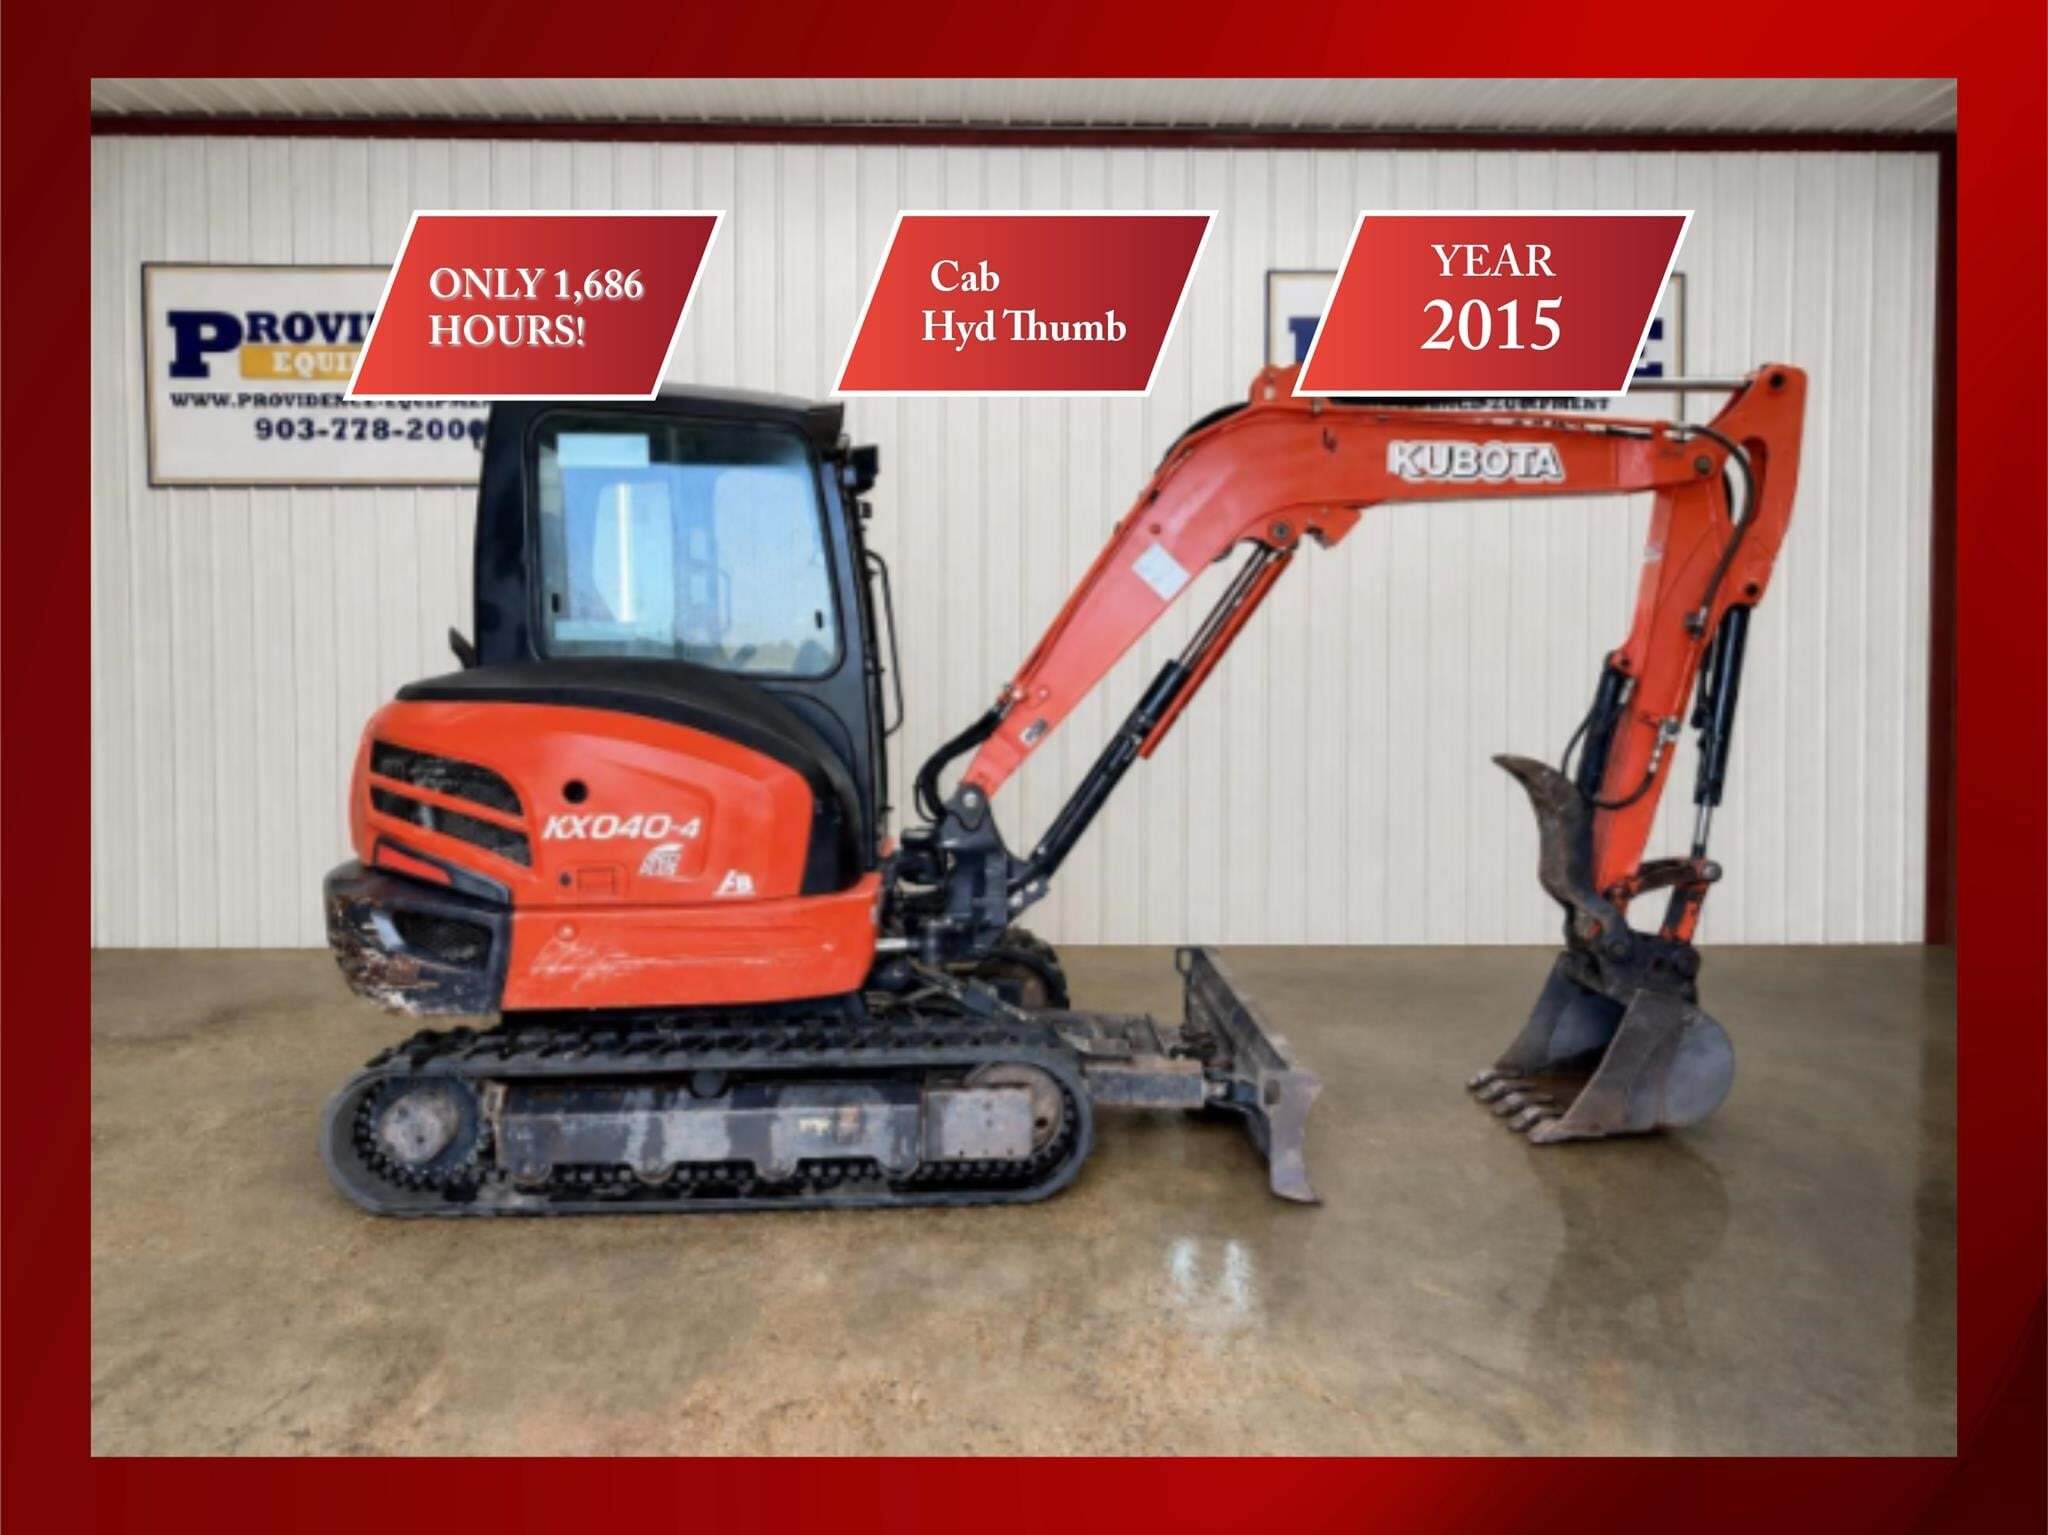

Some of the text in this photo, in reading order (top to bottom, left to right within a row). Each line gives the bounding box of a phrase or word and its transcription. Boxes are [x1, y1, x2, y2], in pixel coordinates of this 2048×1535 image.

[167, 310, 375, 378] PROVI
[1388, 440, 1564, 481] KUBOTA
[543, 815, 700, 840] KX040-4
